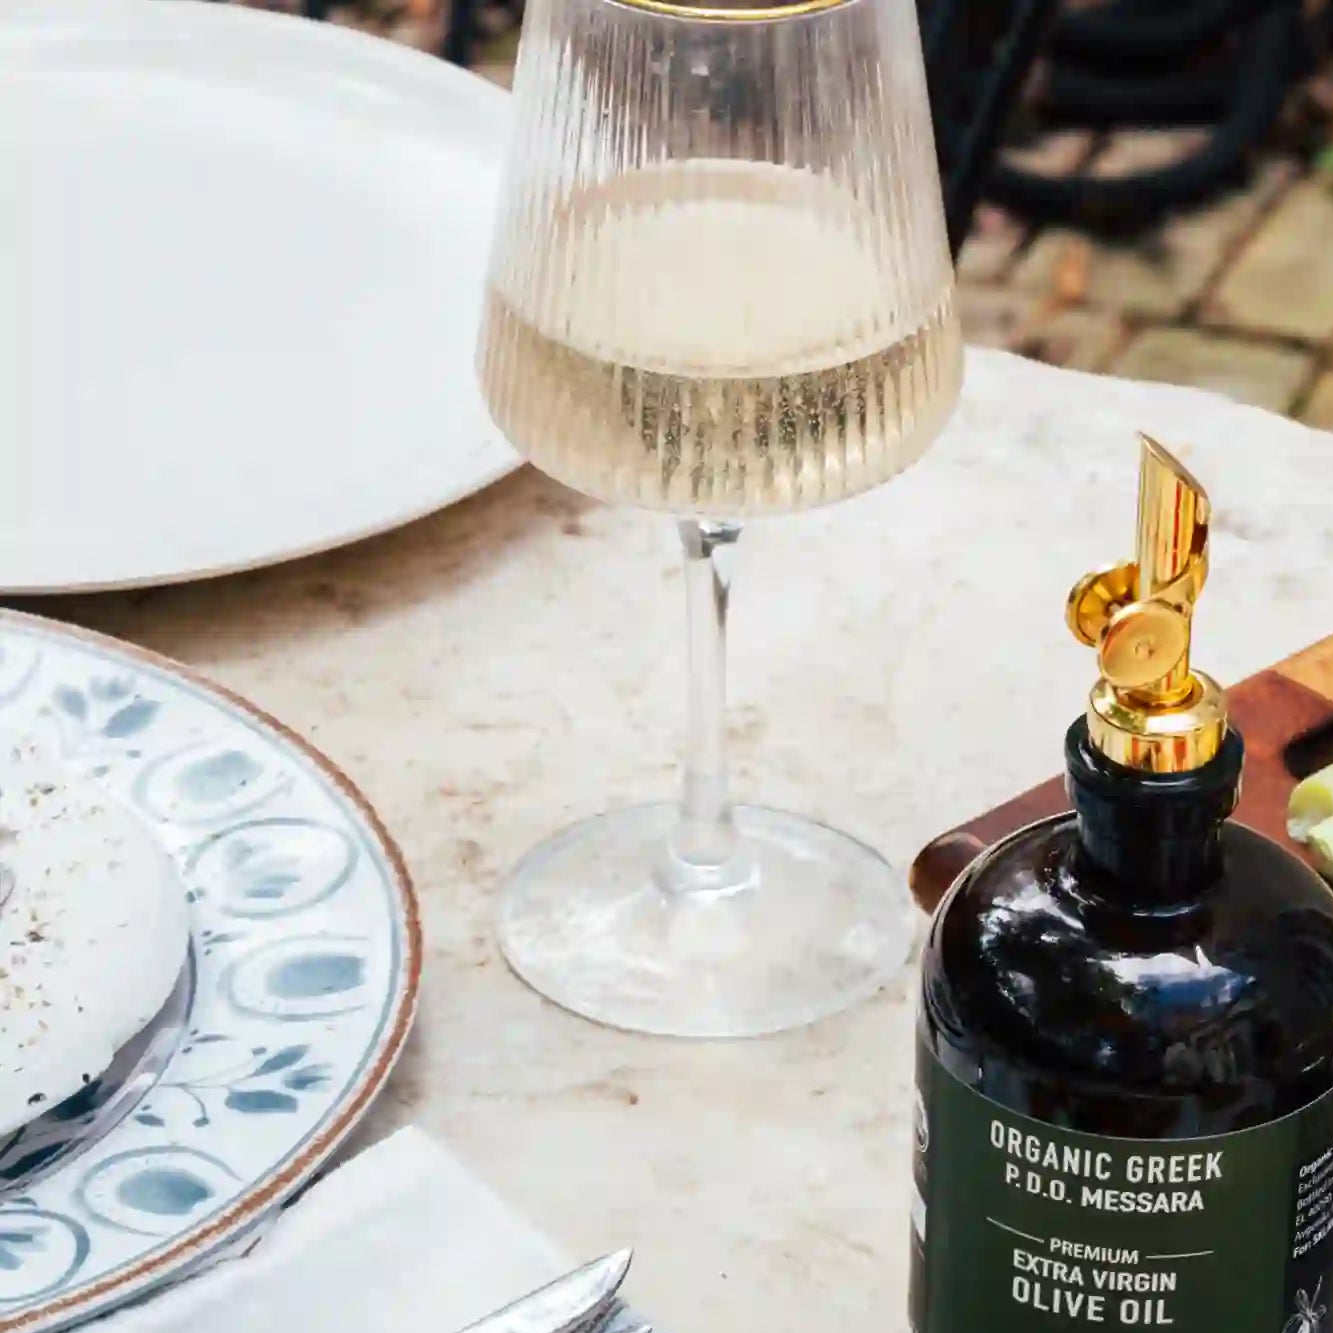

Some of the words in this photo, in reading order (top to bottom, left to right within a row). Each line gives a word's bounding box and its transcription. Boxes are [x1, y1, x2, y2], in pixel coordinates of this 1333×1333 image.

[989, 1120, 1113, 1181] ORGANIC
[1126, 1151, 1224, 1184] GREEK
[1005, 1163, 1073, 1204] P.D.O.
[1081, 1187, 1205, 1214] MESSARA
[1012, 1249, 1084, 1287] EXTRA
[1092, 1269, 1177, 1292] VIRGIN
[1049, 1237, 1139, 1265] PREMIUM
[1012, 1277, 1105, 1323] OLIVE
[1120, 1299, 1175, 1325] OIL
